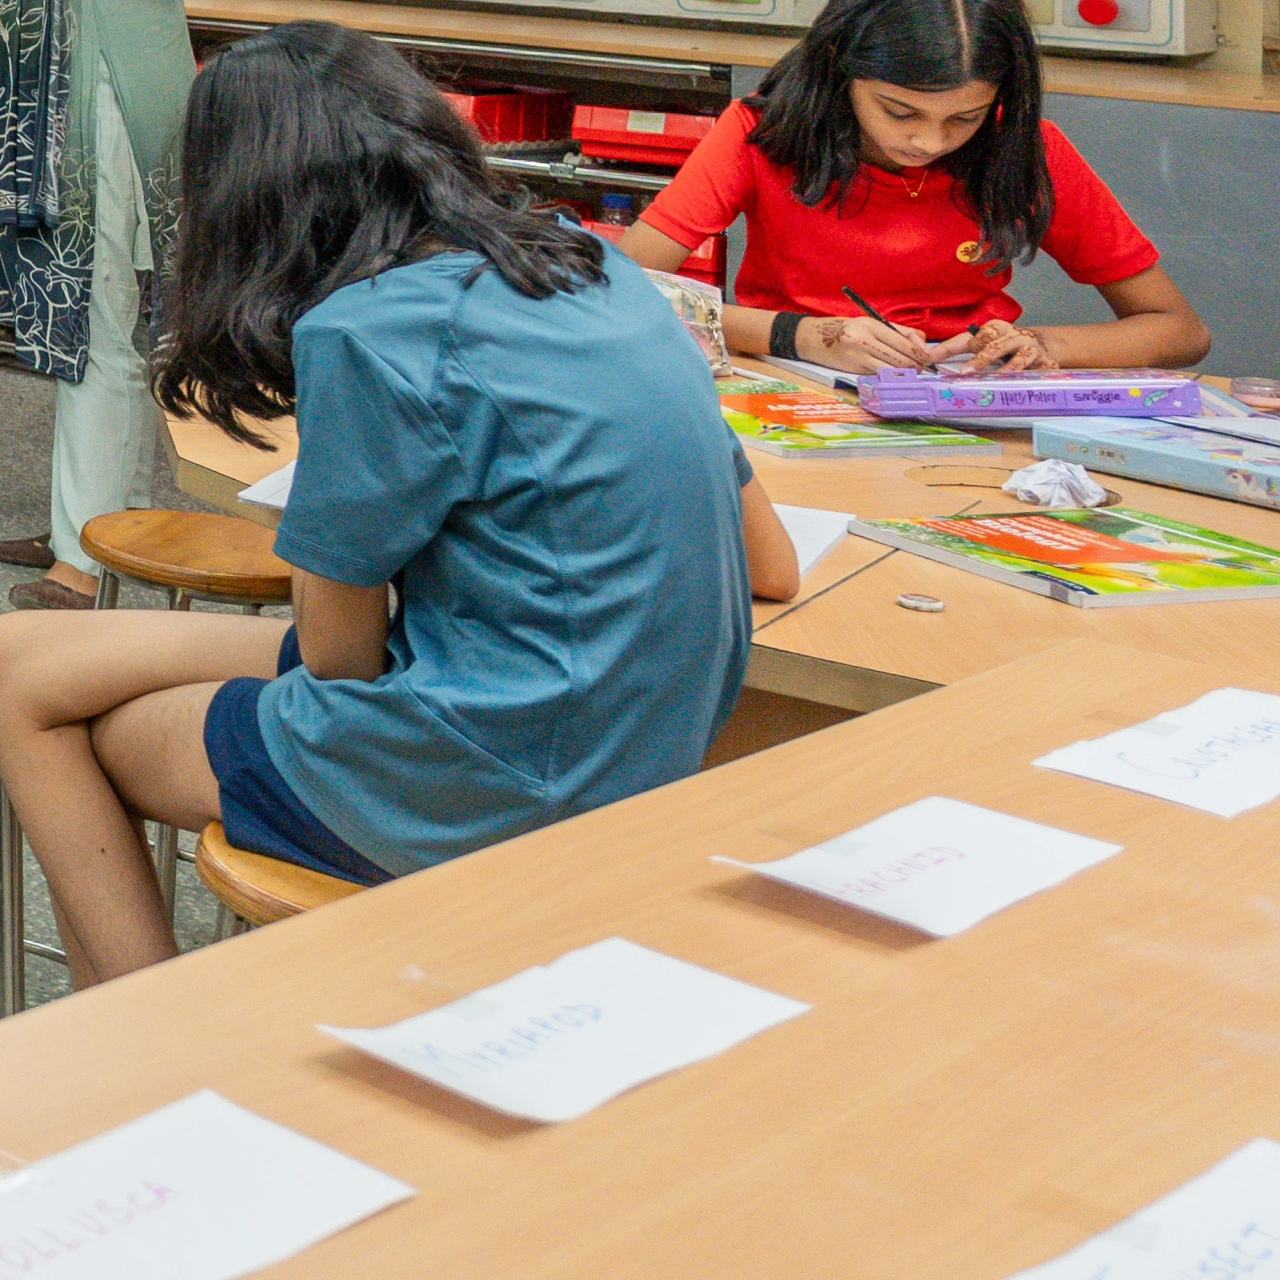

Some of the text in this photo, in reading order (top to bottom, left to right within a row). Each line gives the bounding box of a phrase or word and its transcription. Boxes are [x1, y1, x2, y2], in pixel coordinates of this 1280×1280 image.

[1000, 389, 1058, 407] Harry Potter
[1073, 389, 1121, 404] smiggle
